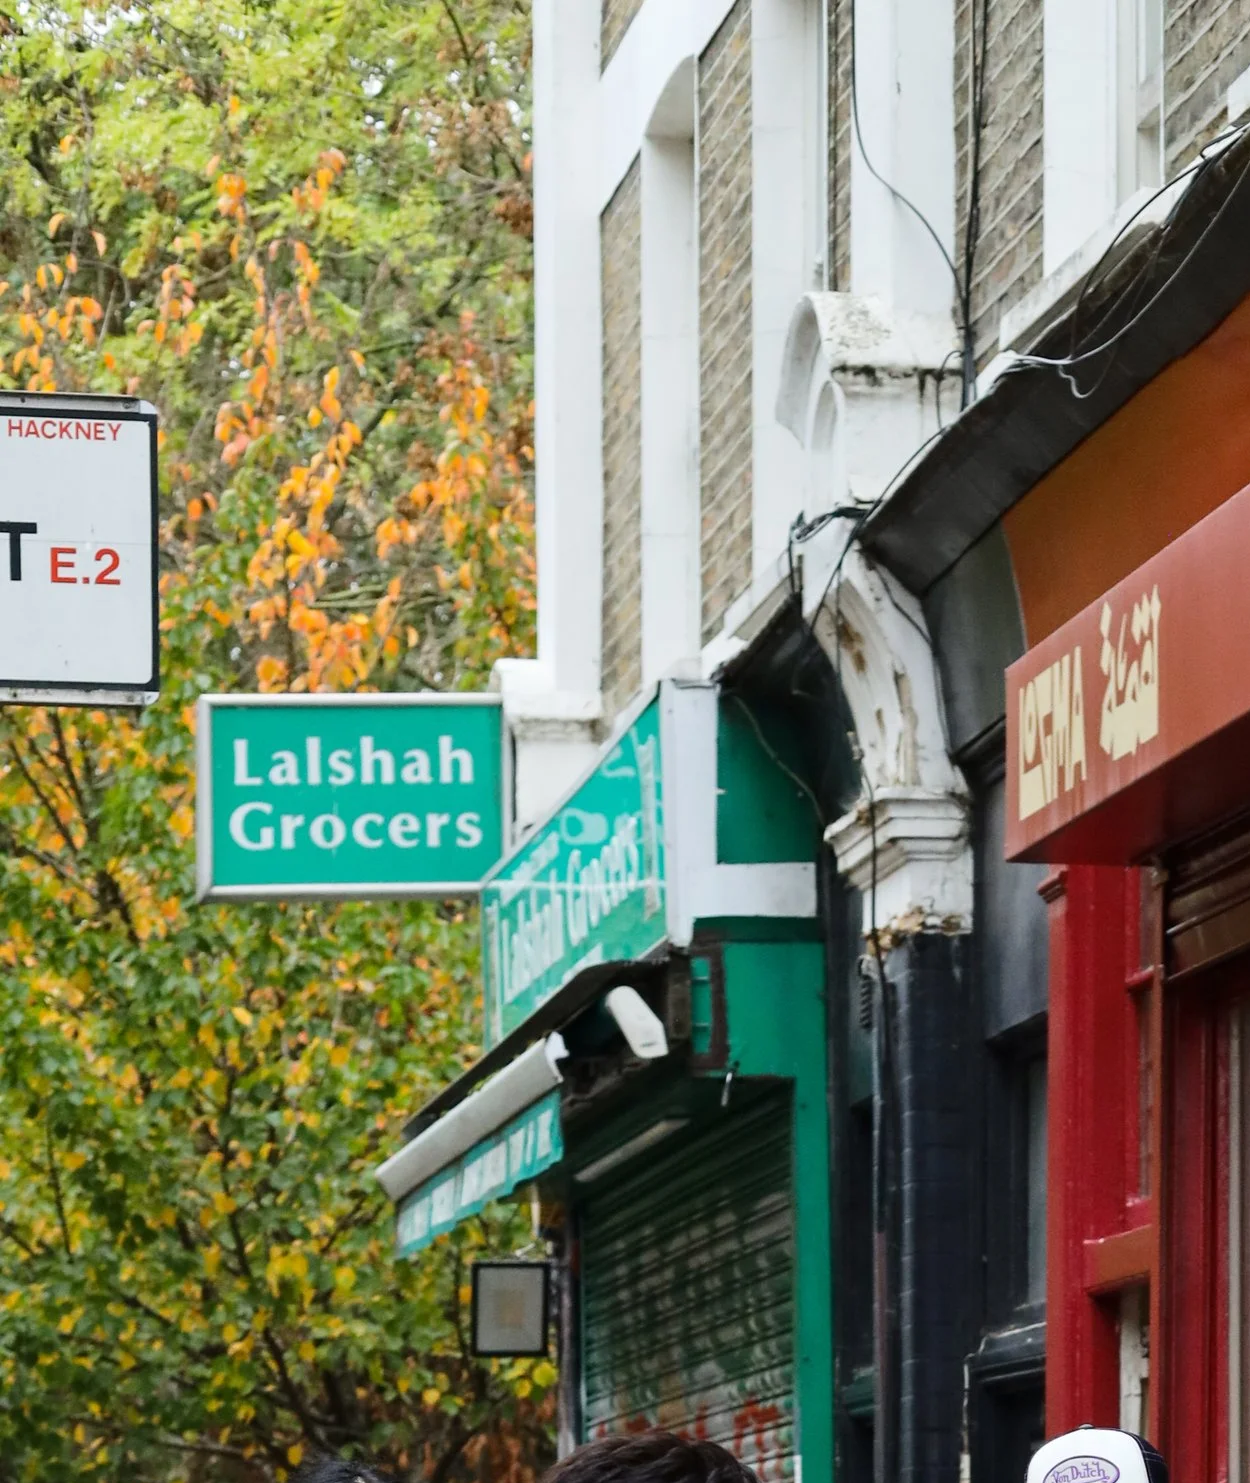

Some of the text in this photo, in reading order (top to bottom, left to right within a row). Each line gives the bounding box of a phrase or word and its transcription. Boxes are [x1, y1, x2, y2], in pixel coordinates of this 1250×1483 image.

[8, 419, 122, 441] HACKNEY
[51, 547, 121, 586] E.2
[233, 735, 475, 786] Lalshah
[229, 801, 483, 850] Grocers
[1071, 1461, 1110, 1480] Dutch
